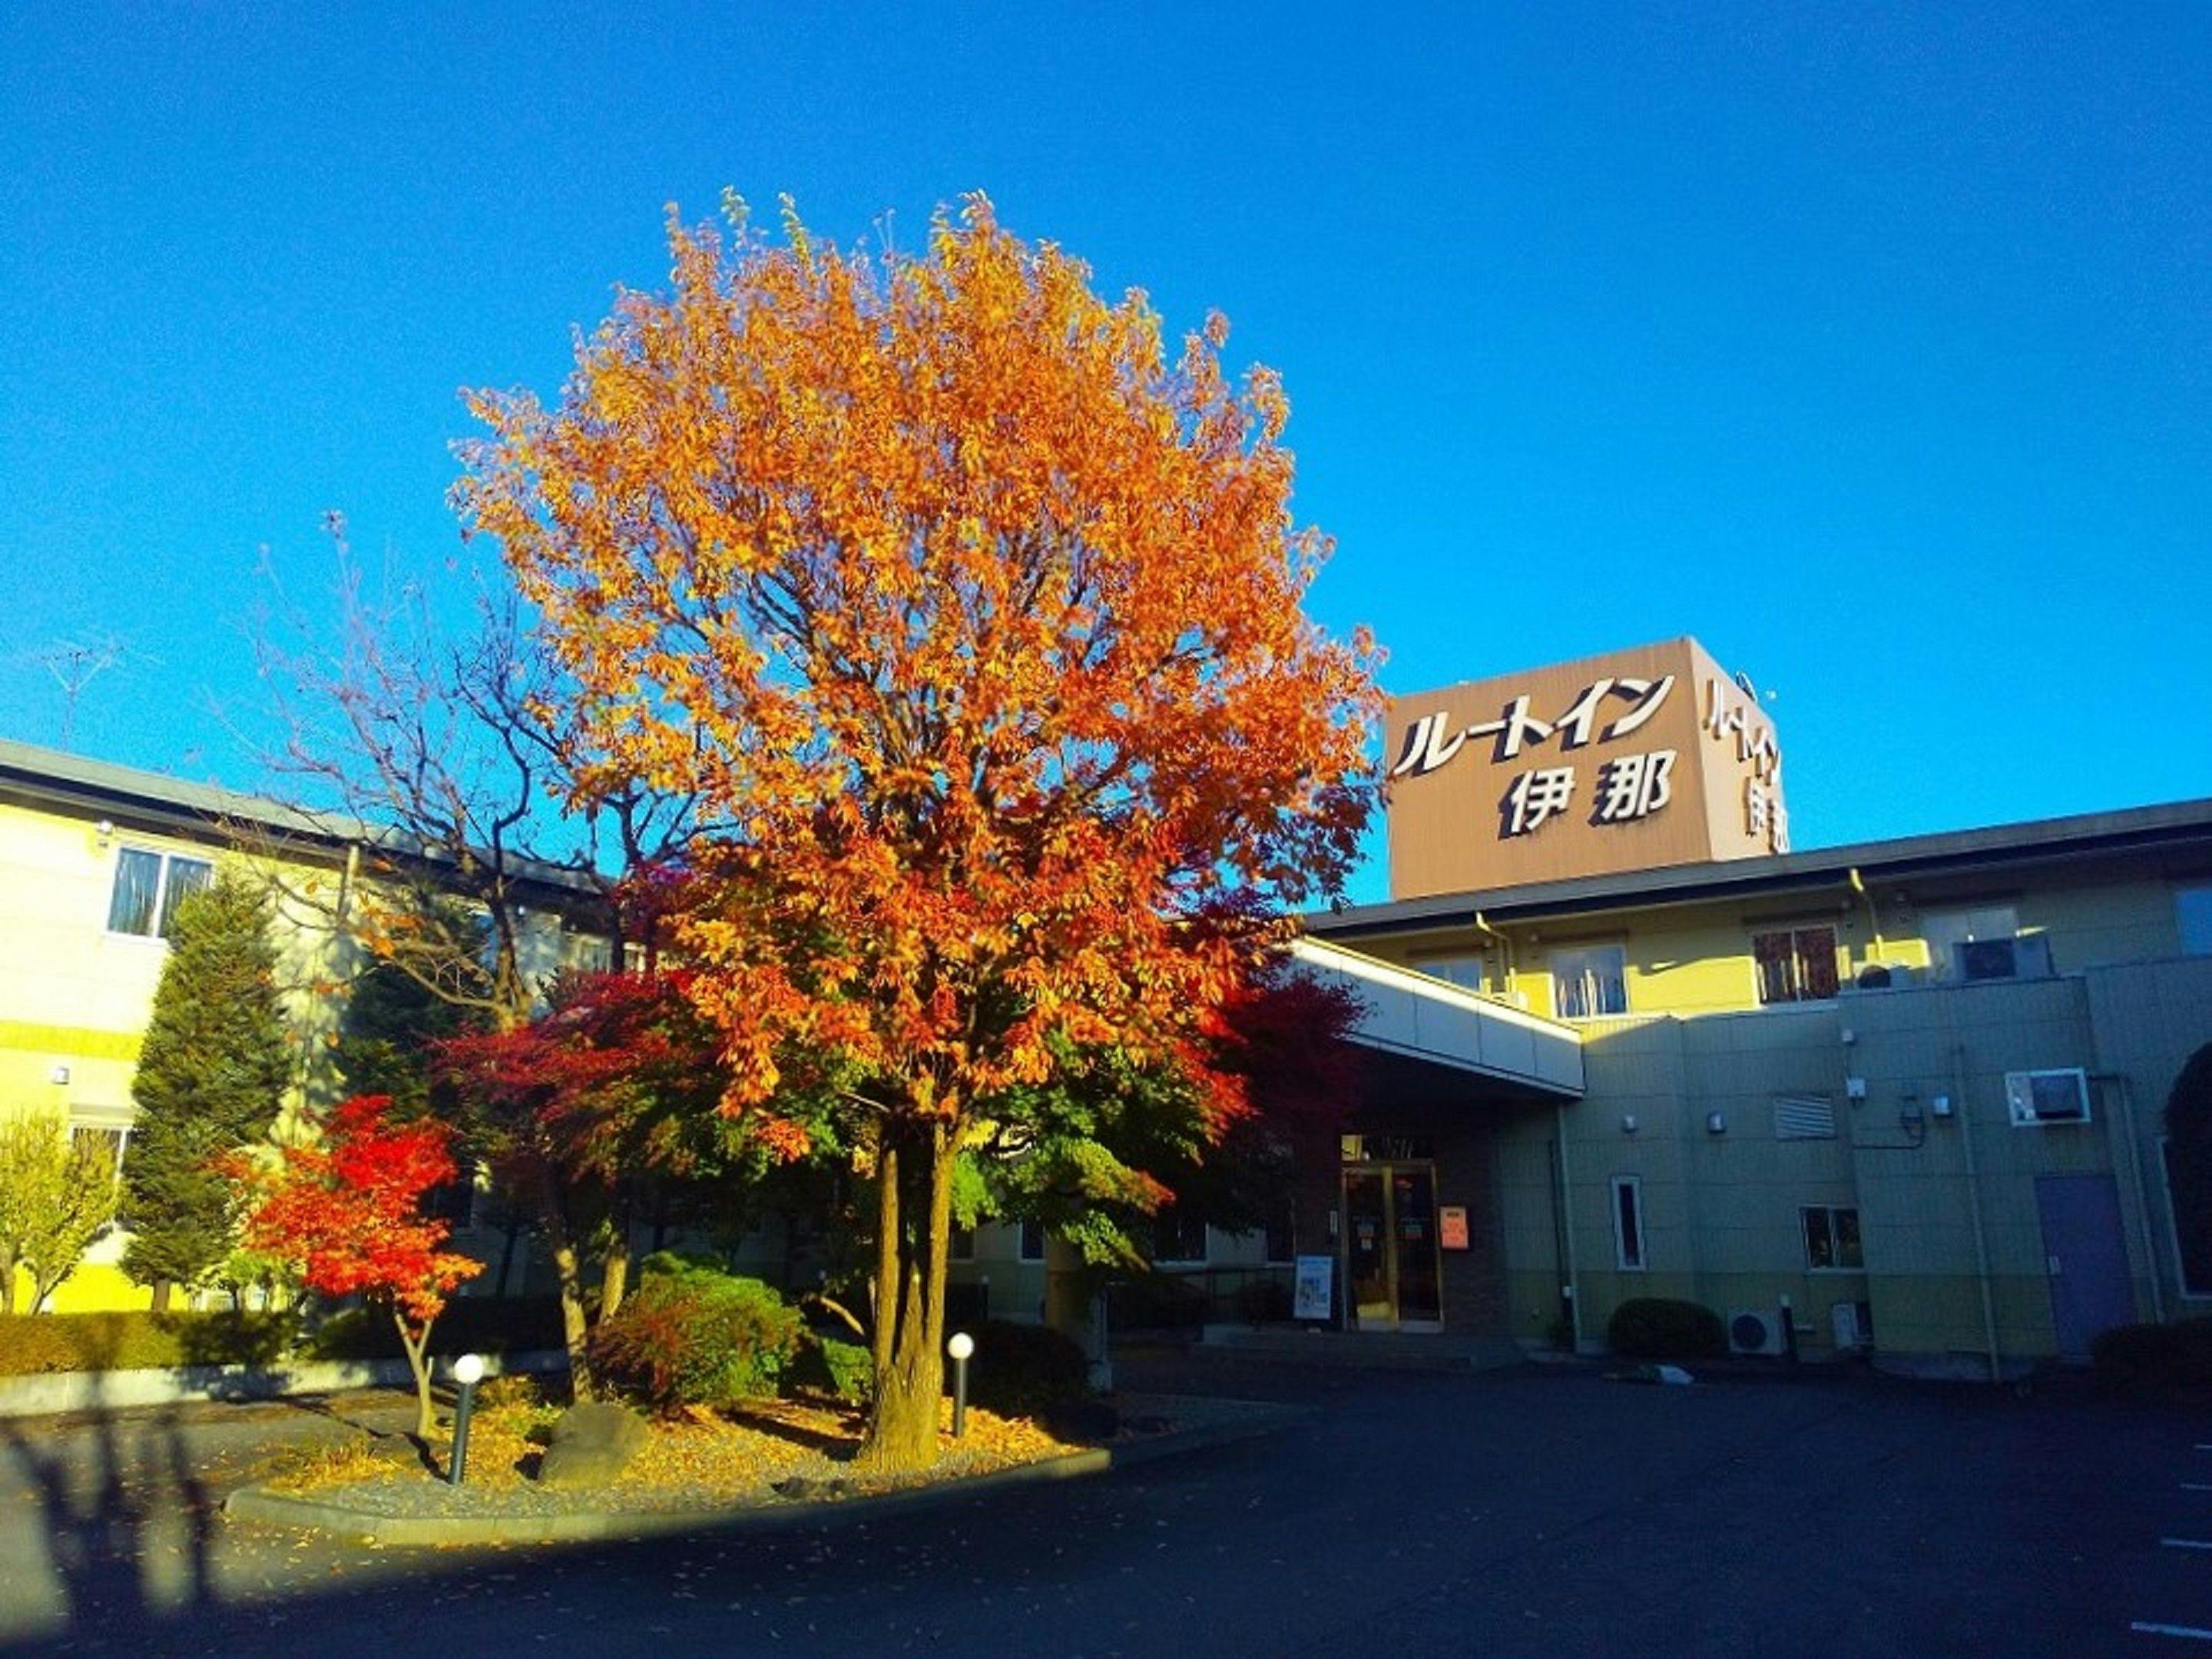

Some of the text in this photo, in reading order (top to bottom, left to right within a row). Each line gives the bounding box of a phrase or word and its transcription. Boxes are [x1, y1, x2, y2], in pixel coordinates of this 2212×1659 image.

[1392, 675, 1676, 776] ルートイン
[1508, 748, 1677, 834] 伊那
